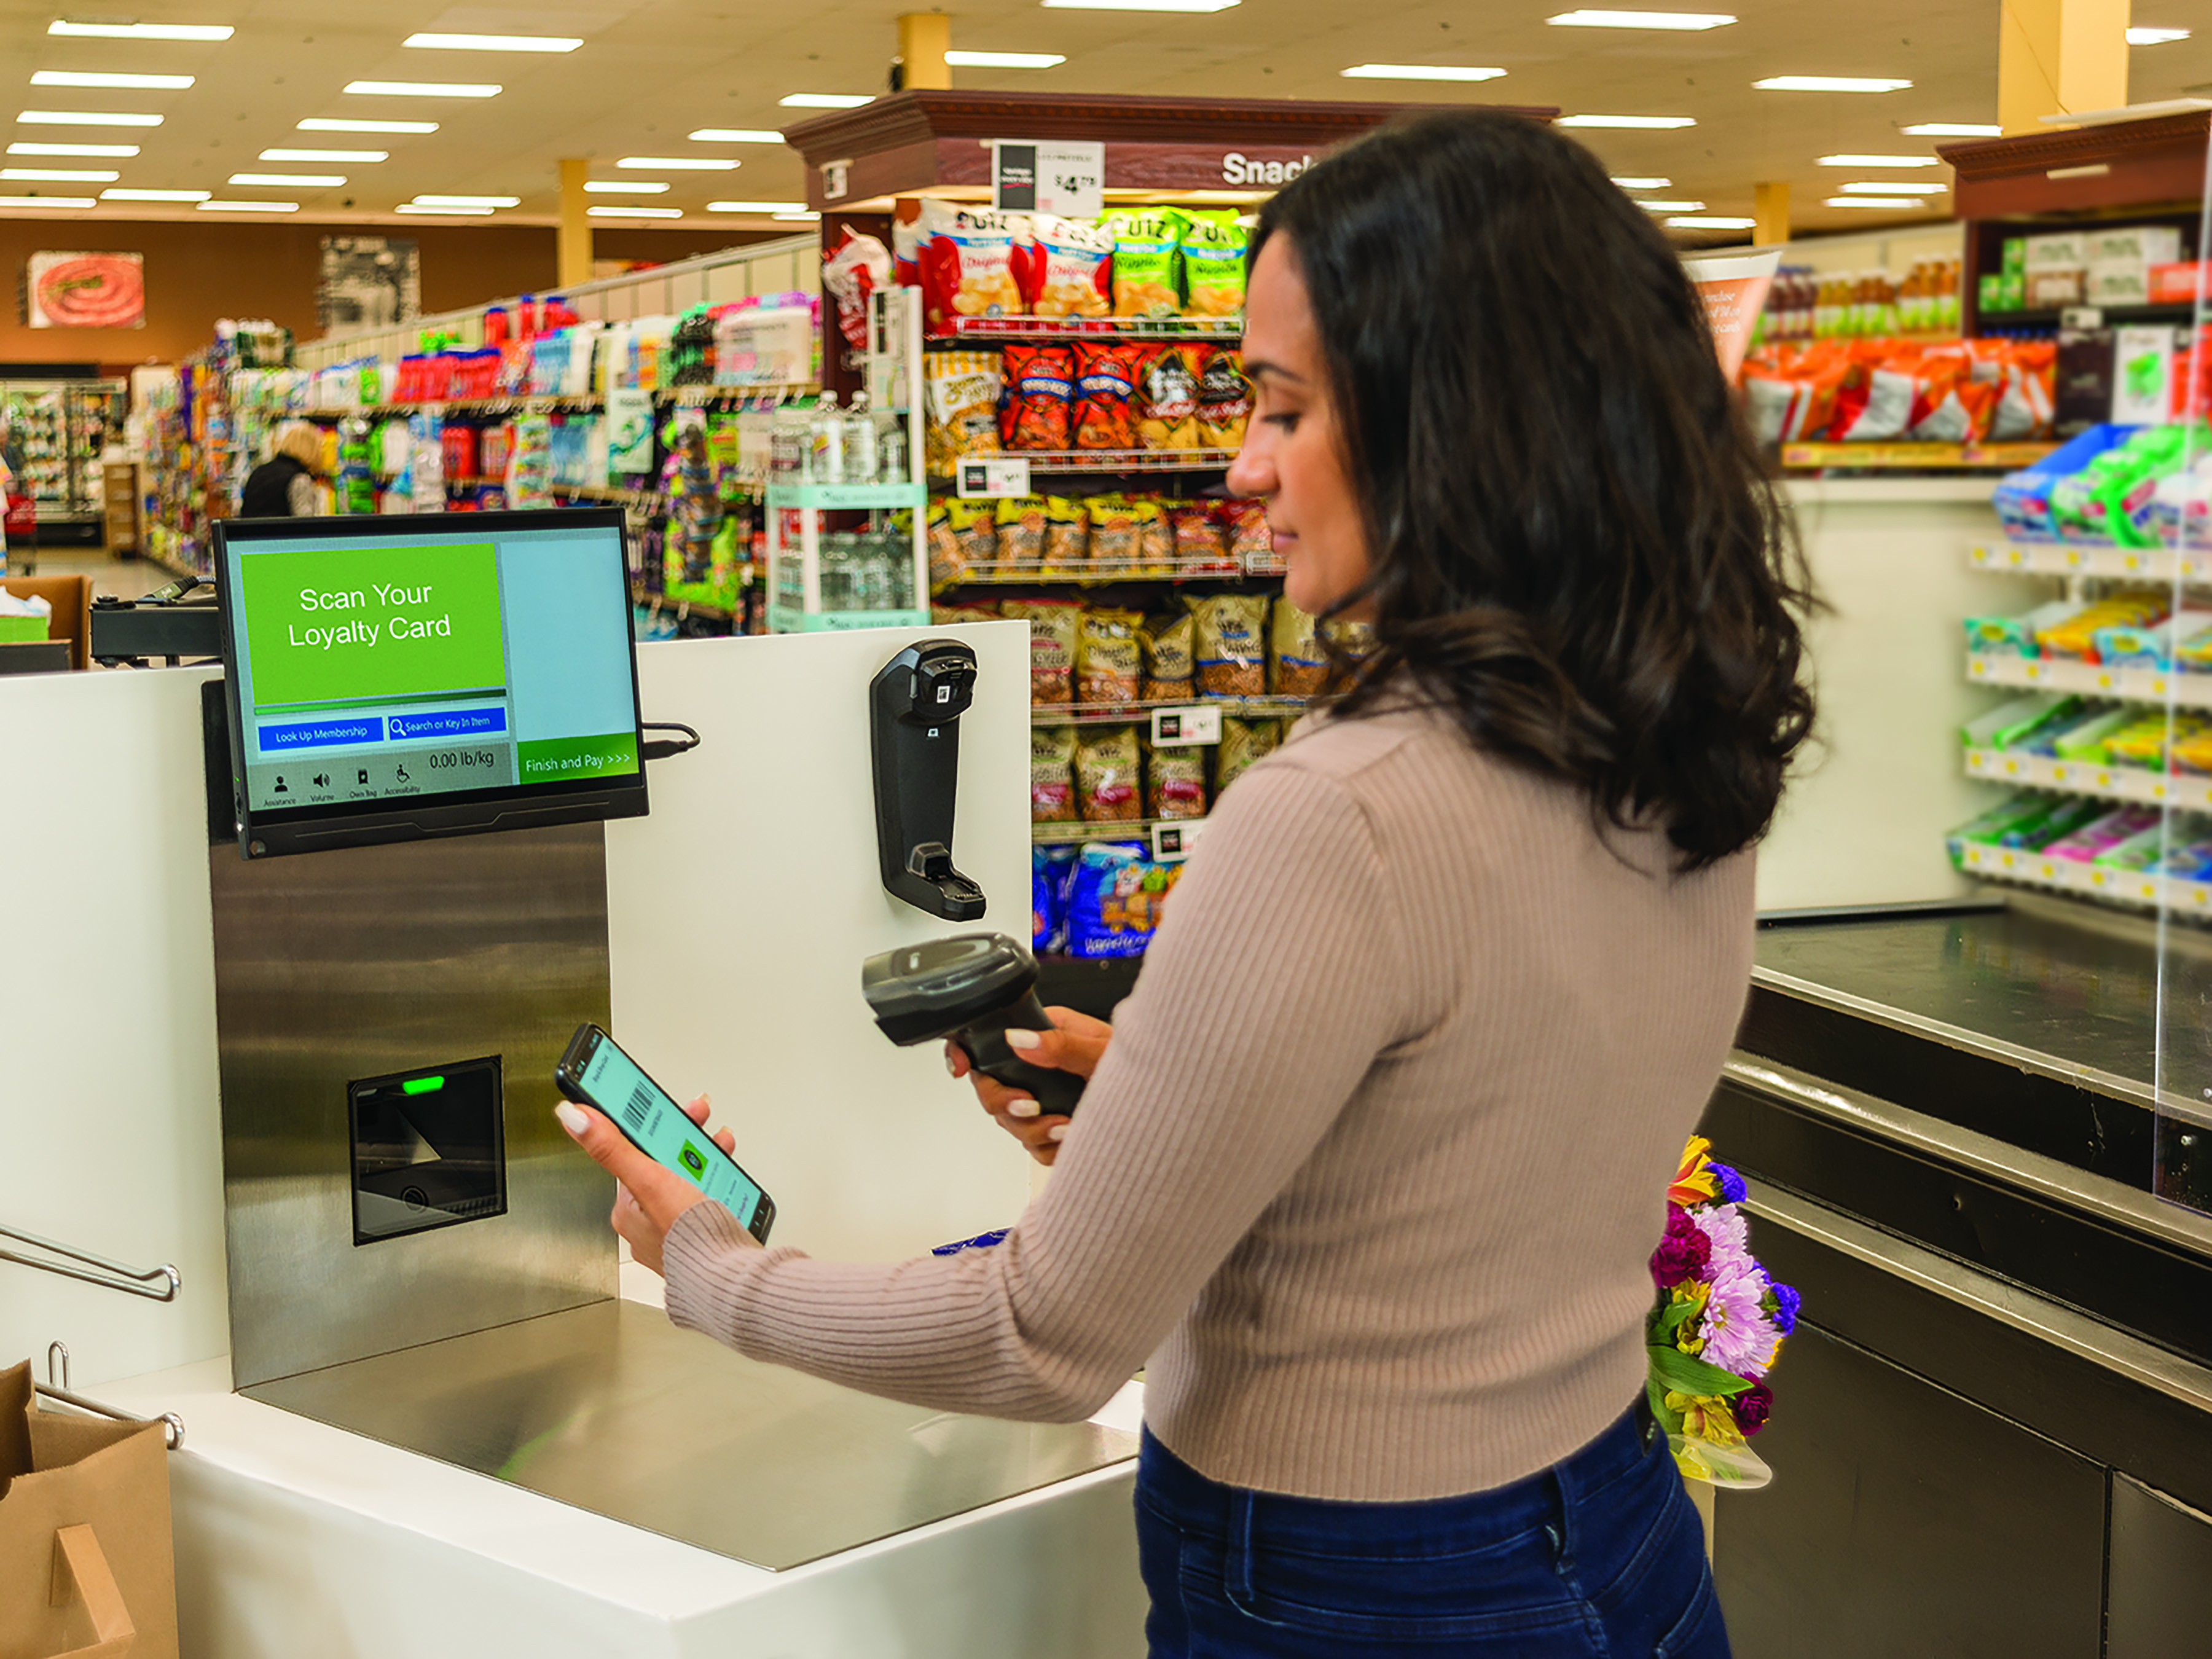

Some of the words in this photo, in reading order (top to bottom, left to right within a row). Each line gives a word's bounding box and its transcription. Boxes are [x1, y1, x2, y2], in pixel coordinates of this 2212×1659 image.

[300, 589, 366, 611] Scan
[372, 583, 432, 606] Your
[289, 620, 380, 650] Loyalty
[389, 614, 452, 640] Card
[406, 721, 433, 732] Search
[445, 719, 461, 730] Key
[461, 718, 471, 727] In
[471, 717, 490, 726] Item
[276, 732, 298, 743] Look
[299, 731, 313, 742] Up
[314, 726, 368, 740] Membership
[430, 752, 458, 769] 0.00
[461, 750, 494, 768] lb/kg
[526, 758, 559, 772] Finish
[561, 755, 581, 769] and
[585, 754, 604, 769] Pay
[310, 793, 335, 803] Volume
